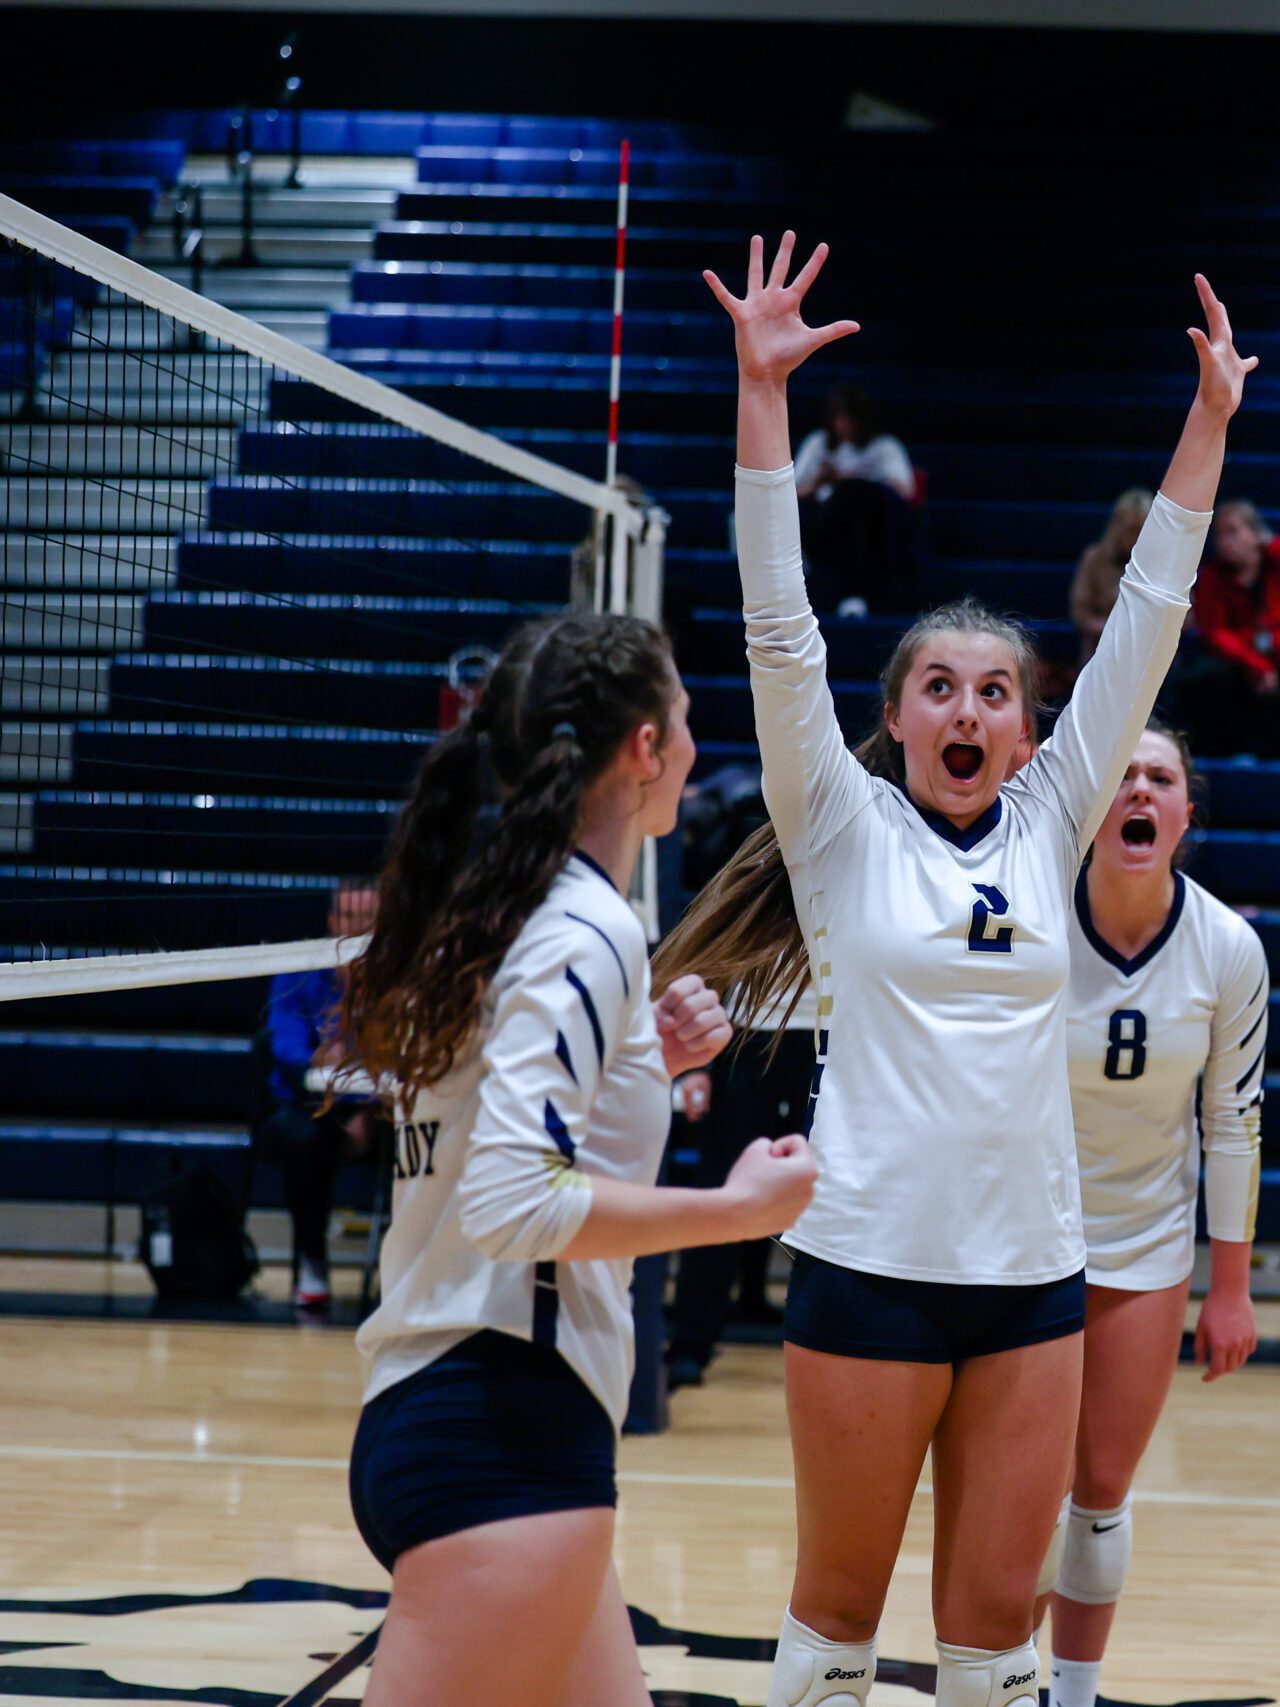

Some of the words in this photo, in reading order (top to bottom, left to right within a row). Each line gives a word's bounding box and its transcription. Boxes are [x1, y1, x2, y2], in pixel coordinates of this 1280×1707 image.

[966, 882, 1015, 954] 2
[1103, 1008, 1148, 1081] 8
[836, 1668, 867, 1681] asics
